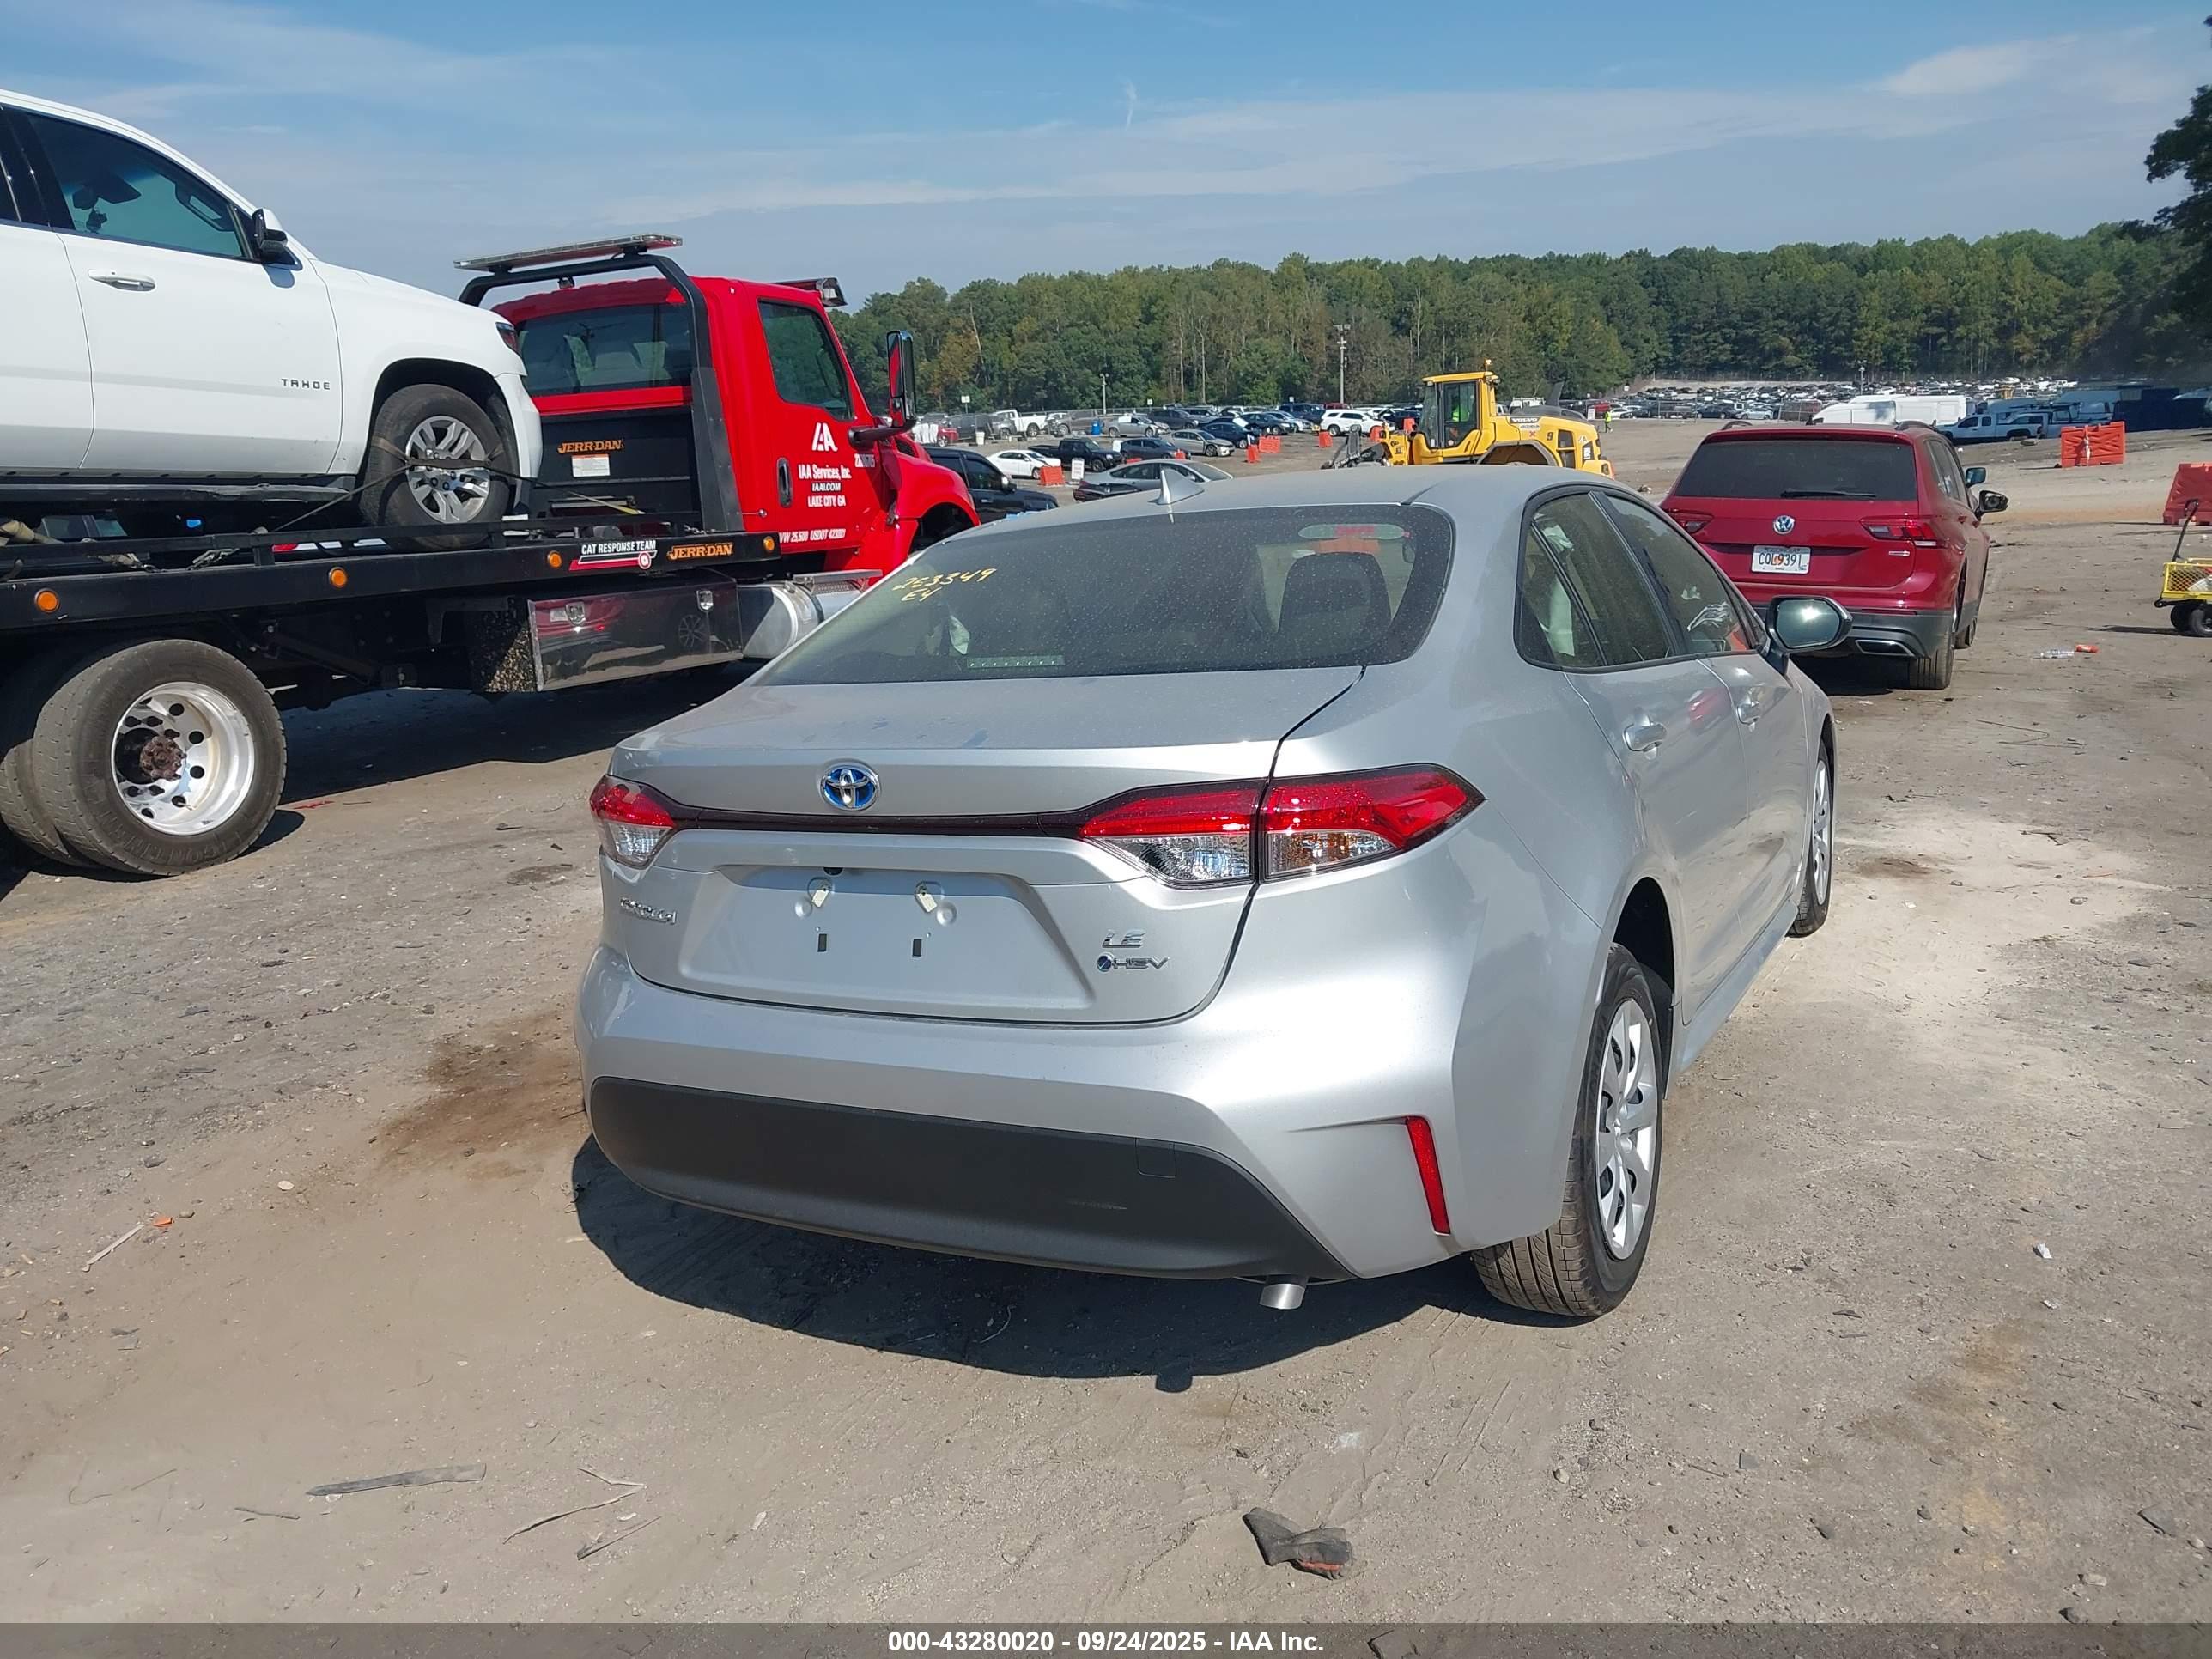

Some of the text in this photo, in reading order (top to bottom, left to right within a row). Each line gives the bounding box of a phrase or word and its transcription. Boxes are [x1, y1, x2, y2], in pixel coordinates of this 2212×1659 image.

[281, 378, 331, 390] TAHOE
[798, 464, 852, 480] IAA Services, Inc.
[811, 483, 841, 491] IAAI.COM
[808, 495, 846, 507] LAKE CITY, GA
[581, 540, 656, 555] CAT RESPONSE TEAM
[1102, 930, 1146, 948] LE
[1112, 957, 1170, 969] HEV
